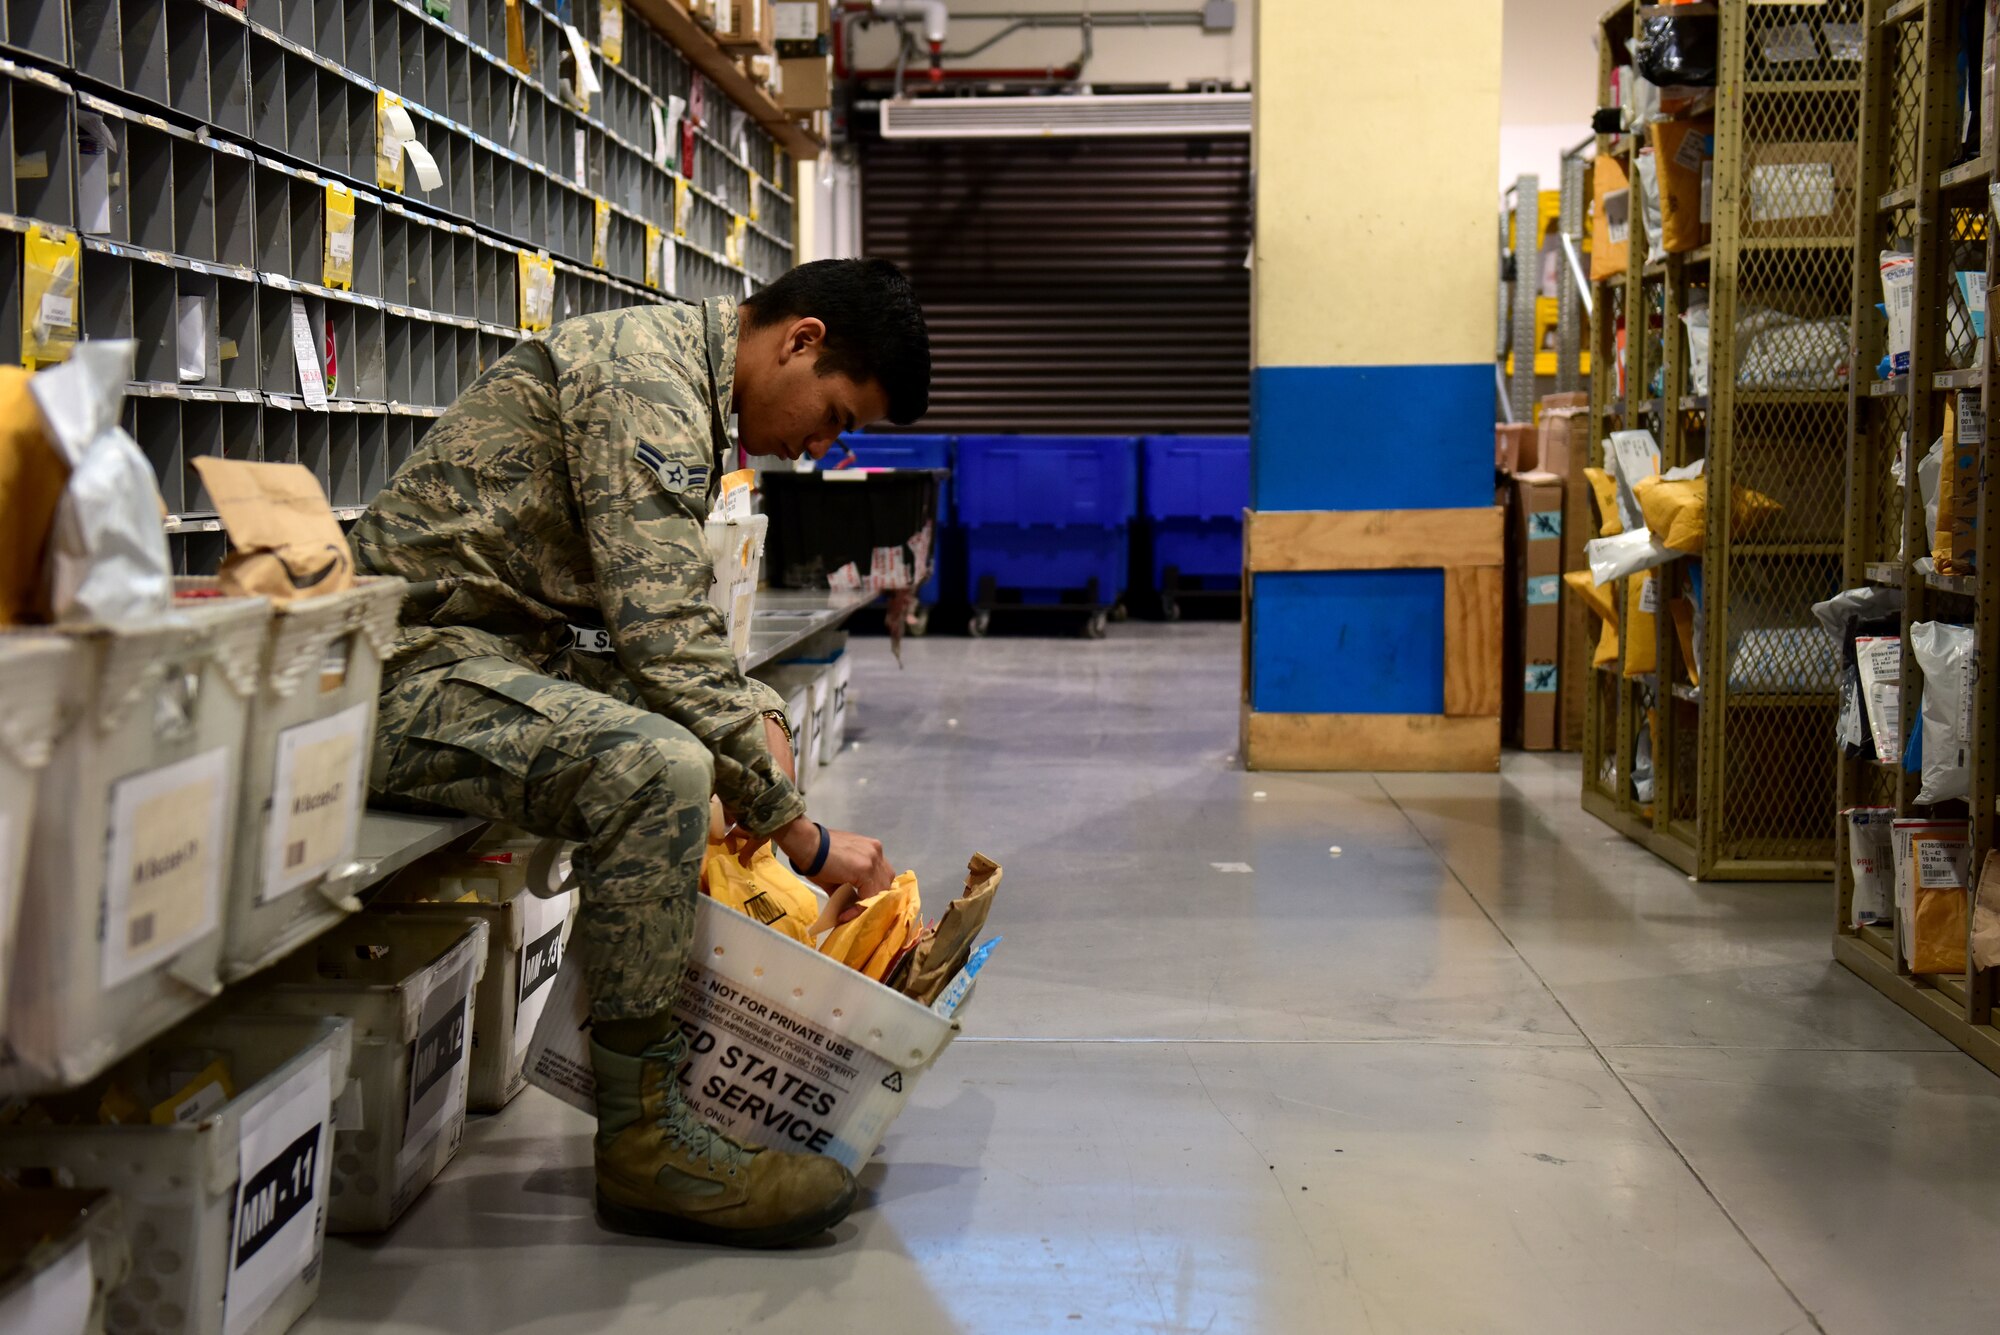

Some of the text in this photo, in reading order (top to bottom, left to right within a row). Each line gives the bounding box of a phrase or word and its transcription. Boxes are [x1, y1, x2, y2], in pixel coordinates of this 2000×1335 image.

[706, 997, 731, 1016] THEFT
[744, 1019, 773, 1038] MISUSE
[785, 1039, 814, 1059] POSTAL
[815, 1054, 857, 1080] PROPERTY
[708, 980, 739, 1002] NOT
[739, 995, 768, 1018] FOR
[769, 1010, 825, 1046] PRIVATE
[825, 1039, 854, 1061] USE
[723, 1020, 782, 1055] IMPRISONMENT
[702, 1075, 834, 1154] SERVICE
[704, 1107, 736, 1128] ONLY
[719, 1045, 836, 1117] STATES
